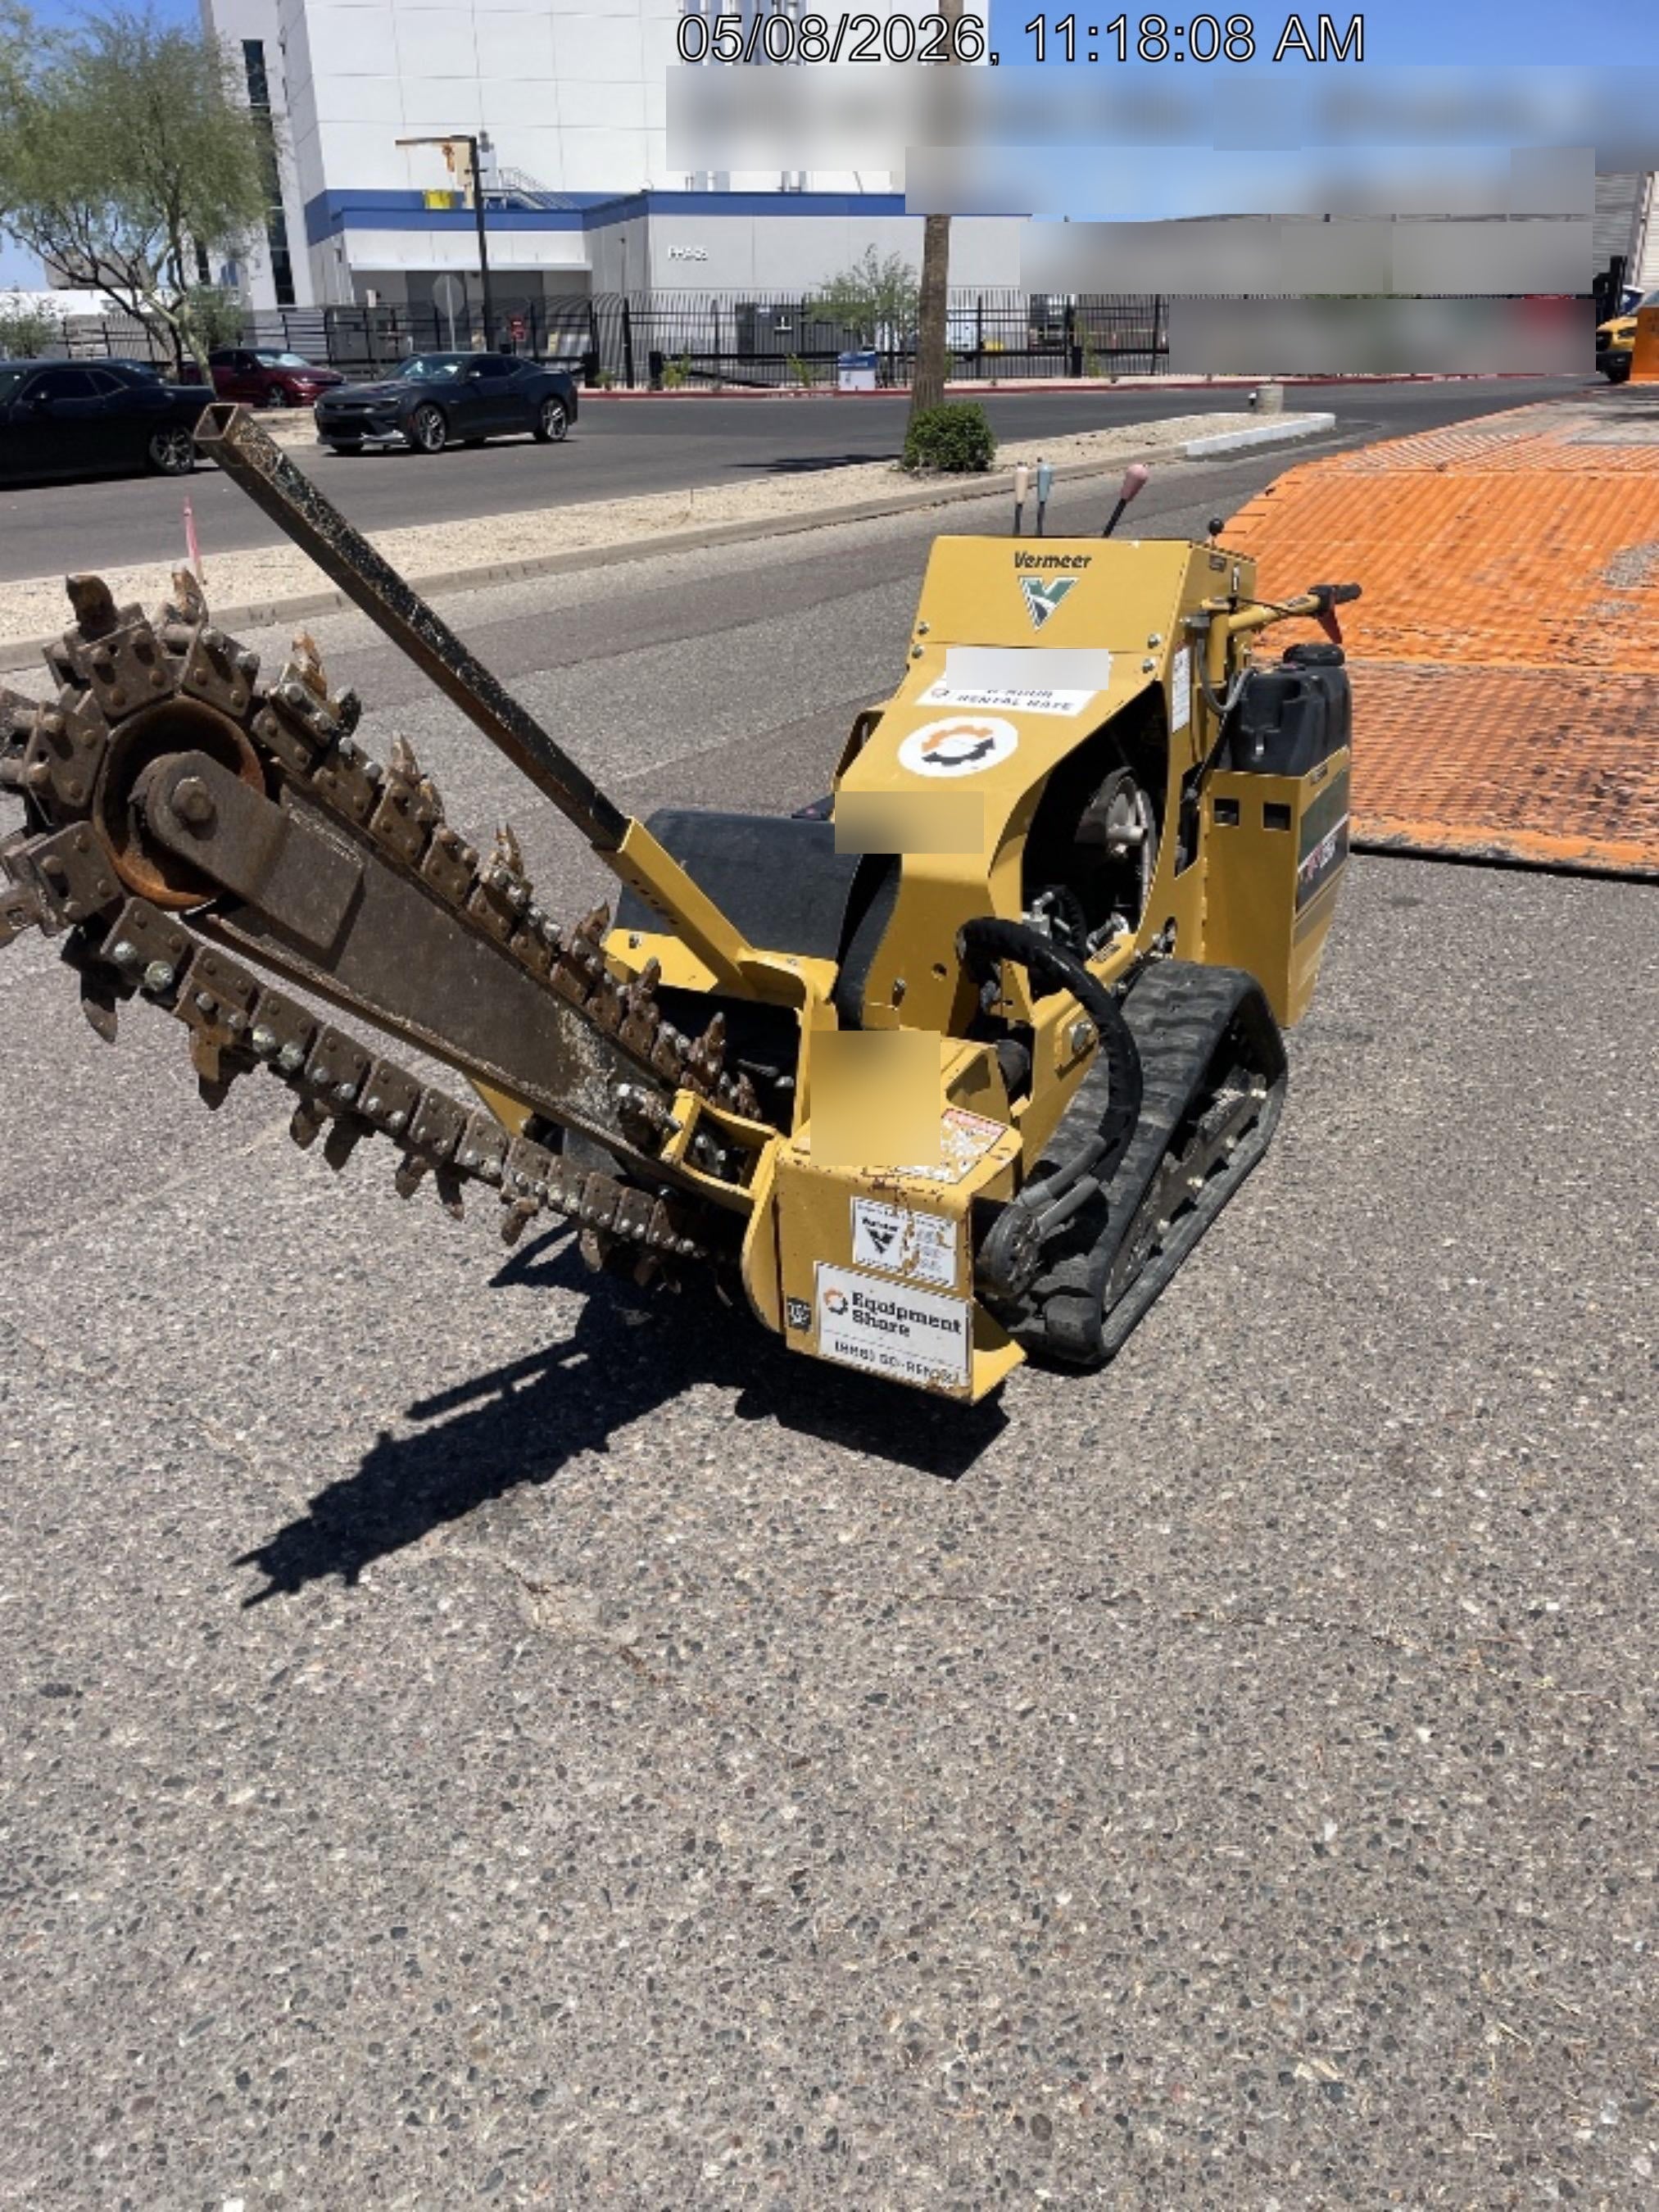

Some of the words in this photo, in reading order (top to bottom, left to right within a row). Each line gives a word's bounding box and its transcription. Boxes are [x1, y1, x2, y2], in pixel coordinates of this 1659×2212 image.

[1014, 551, 1092, 569] Vermeer
[852, 1291, 962, 1335] Equipment
[852, 1308, 911, 1338] Share
